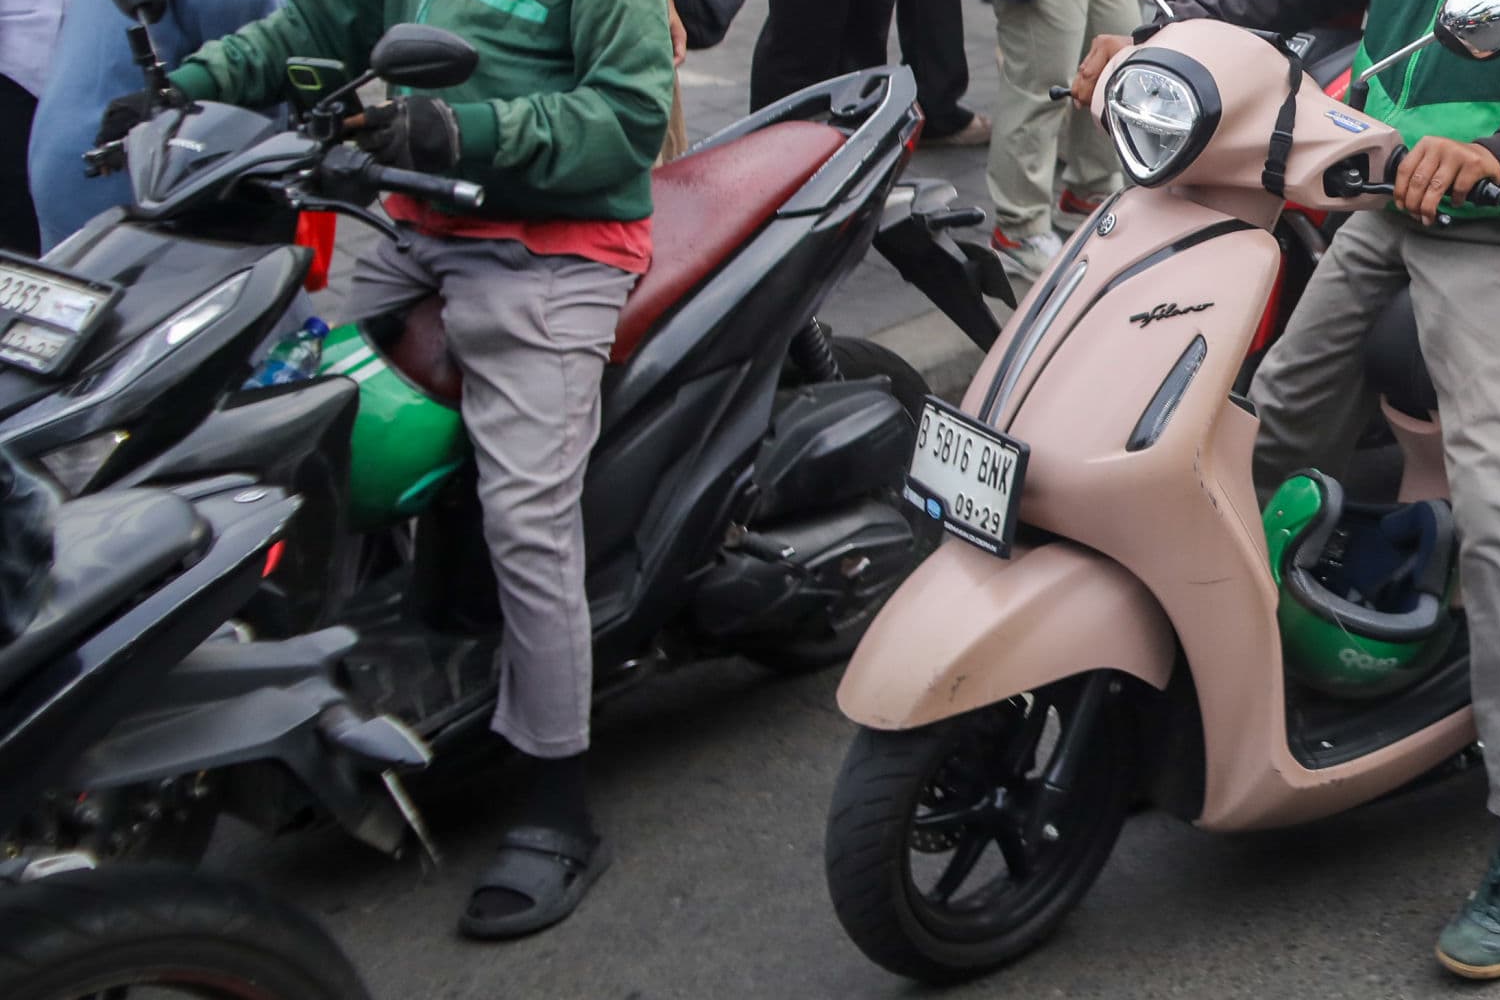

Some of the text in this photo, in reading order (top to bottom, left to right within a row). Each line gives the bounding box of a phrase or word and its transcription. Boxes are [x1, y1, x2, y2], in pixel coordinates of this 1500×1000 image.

[918, 414, 1012, 495] B 5816 BNK
